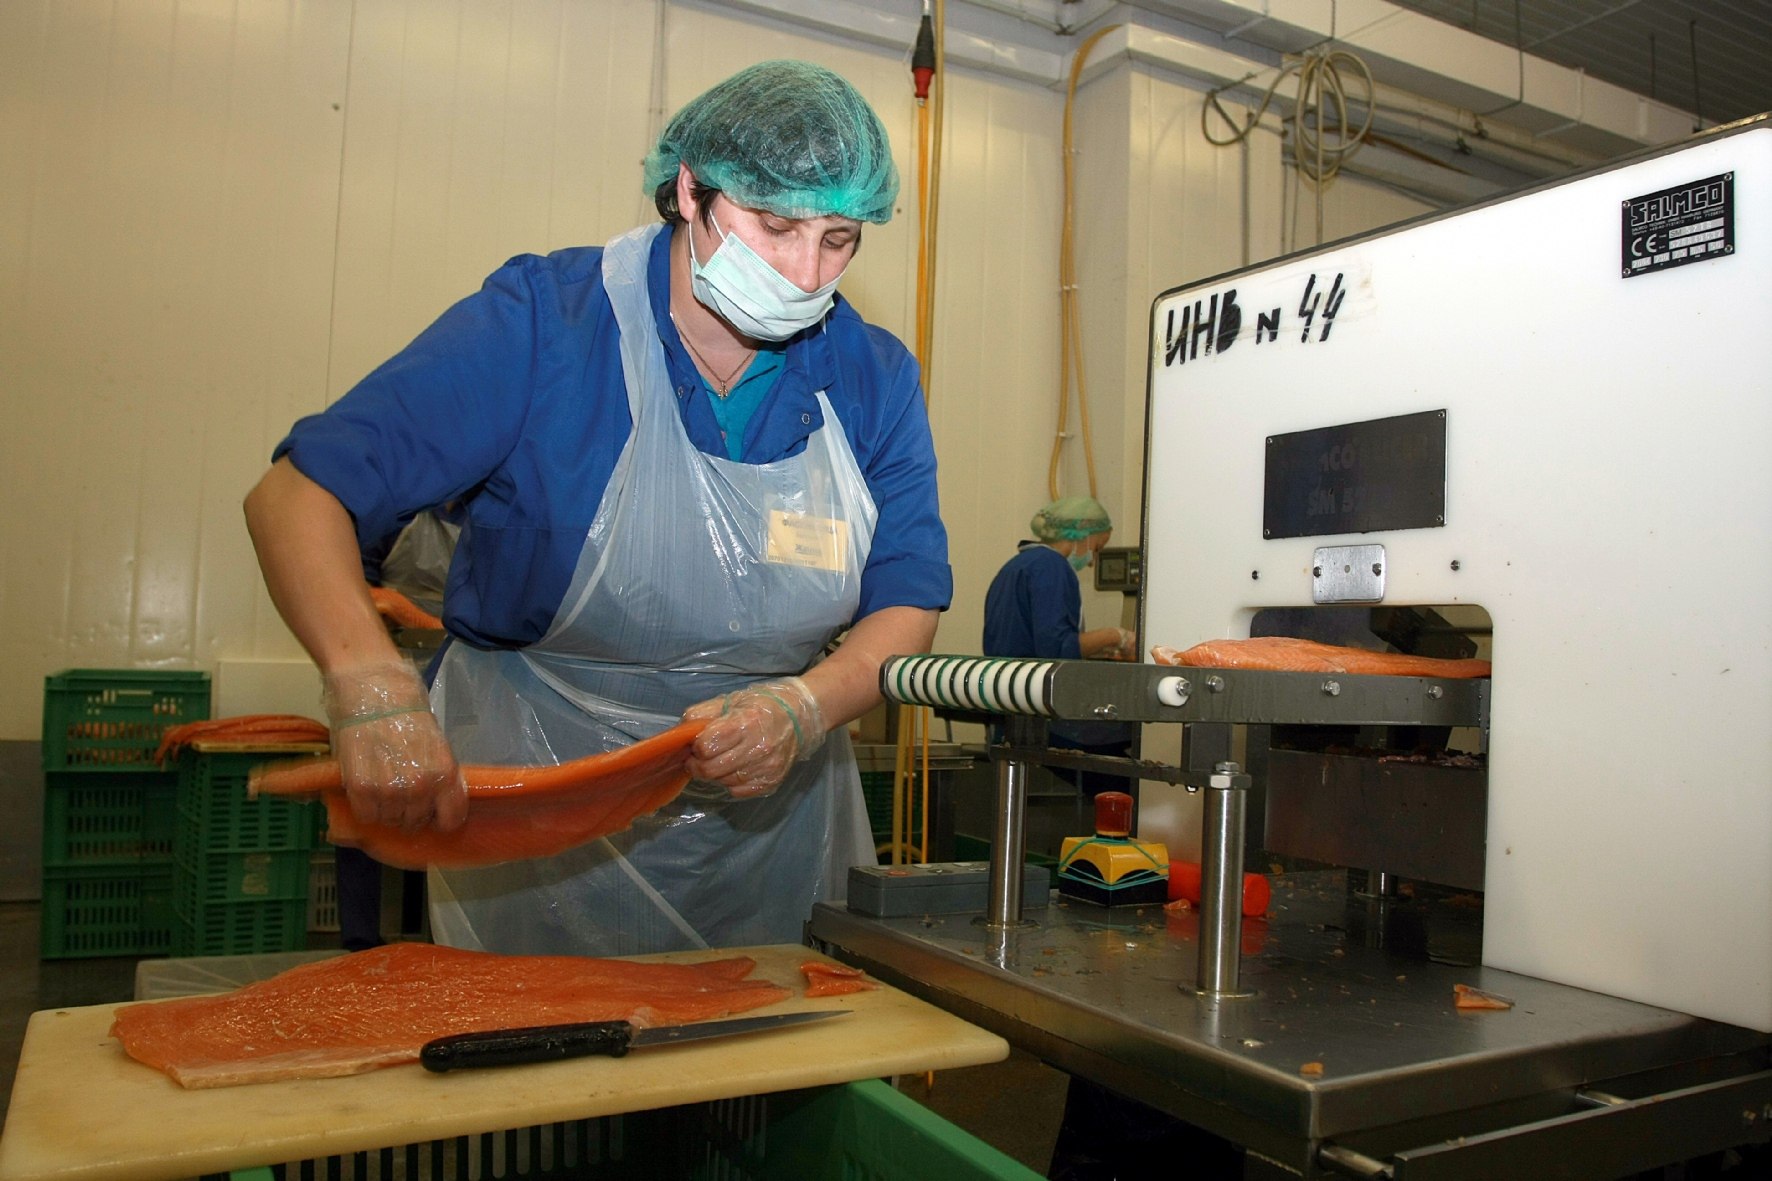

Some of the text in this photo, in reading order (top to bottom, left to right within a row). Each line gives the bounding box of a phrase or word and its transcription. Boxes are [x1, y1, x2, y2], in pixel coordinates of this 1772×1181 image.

[1631, 181, 1724, 227] SALMCO
[1631, 233, 1657, 258] CE
[1298, 273, 1346, 343] 44
